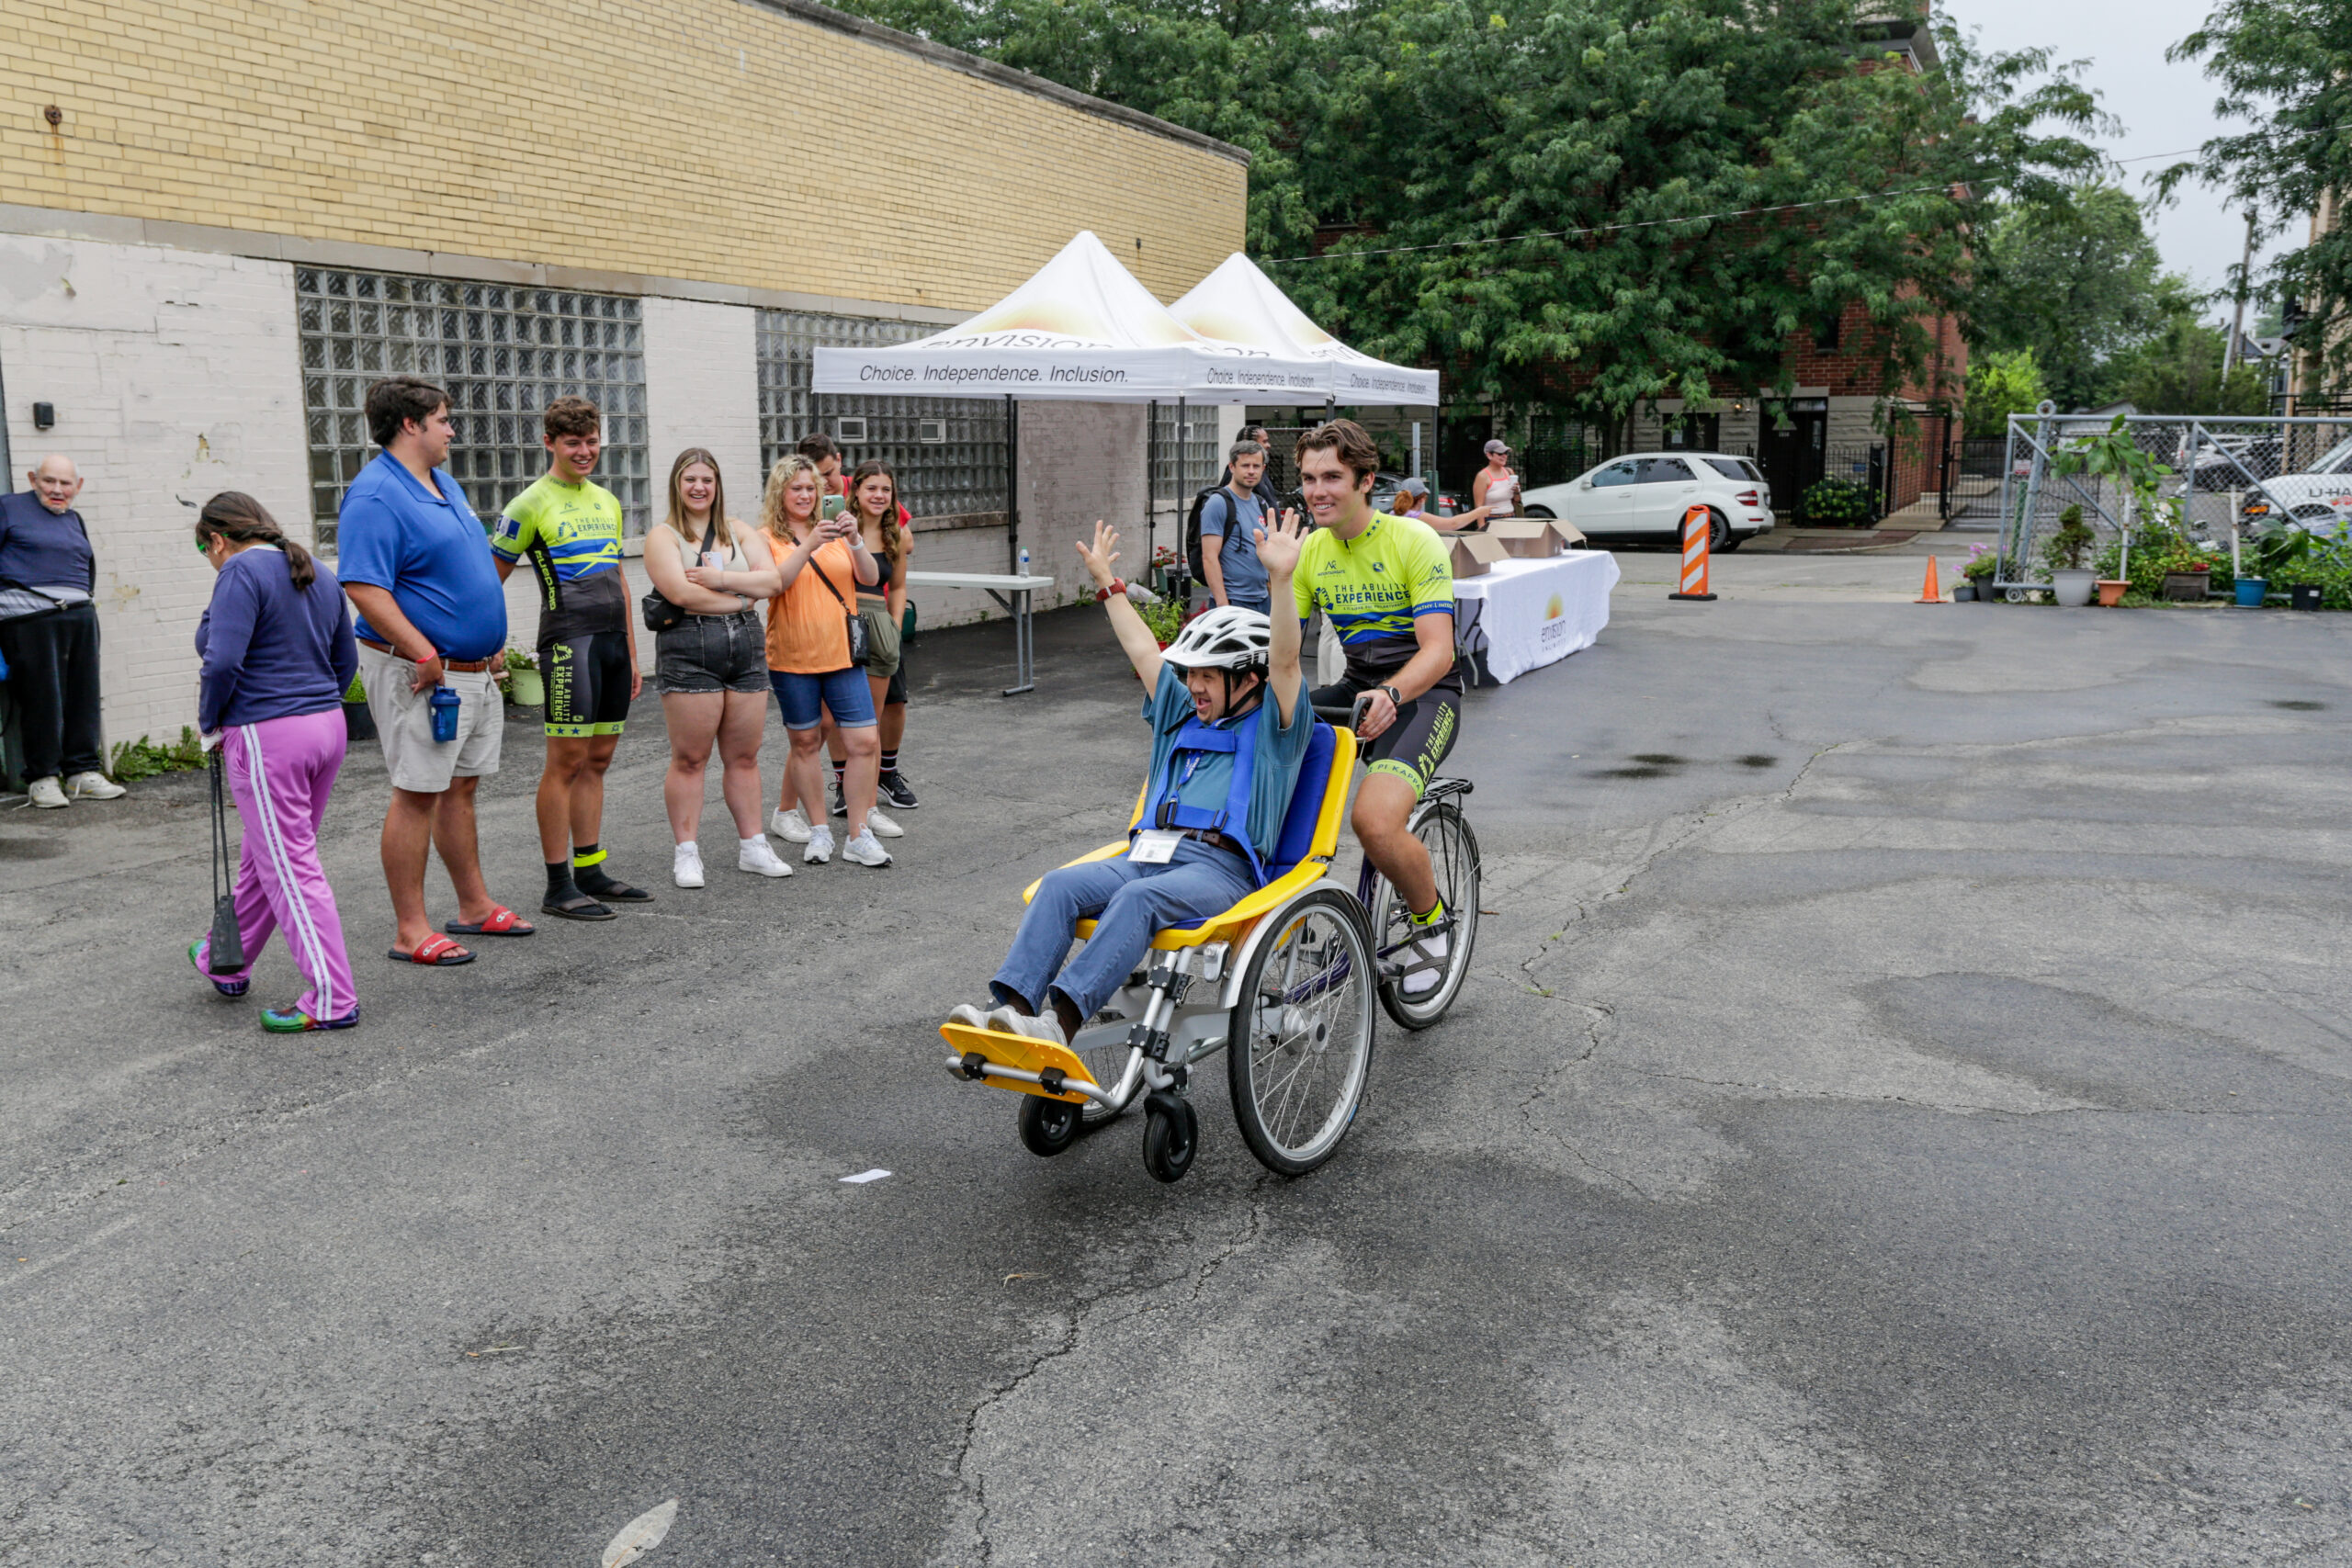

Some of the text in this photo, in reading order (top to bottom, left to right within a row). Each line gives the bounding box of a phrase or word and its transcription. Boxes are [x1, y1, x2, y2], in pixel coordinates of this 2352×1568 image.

[860, 365, 1128, 384] Choice. Independence. Inclusion.
[1207, 367, 1236, 385] Choice.
[1334, 582, 1407, 592] THE ABILITY
[1335, 590, 1410, 604] EXPERIENCE
[555, 665, 565, 722] EXPERIENCE
[563, 665, 573, 722] THE ABILITY
[1425, 732, 1436, 750] THE
[1433, 701, 1449, 733] ABILITY
[1430, 706, 1455, 761] EXPERIENCE
